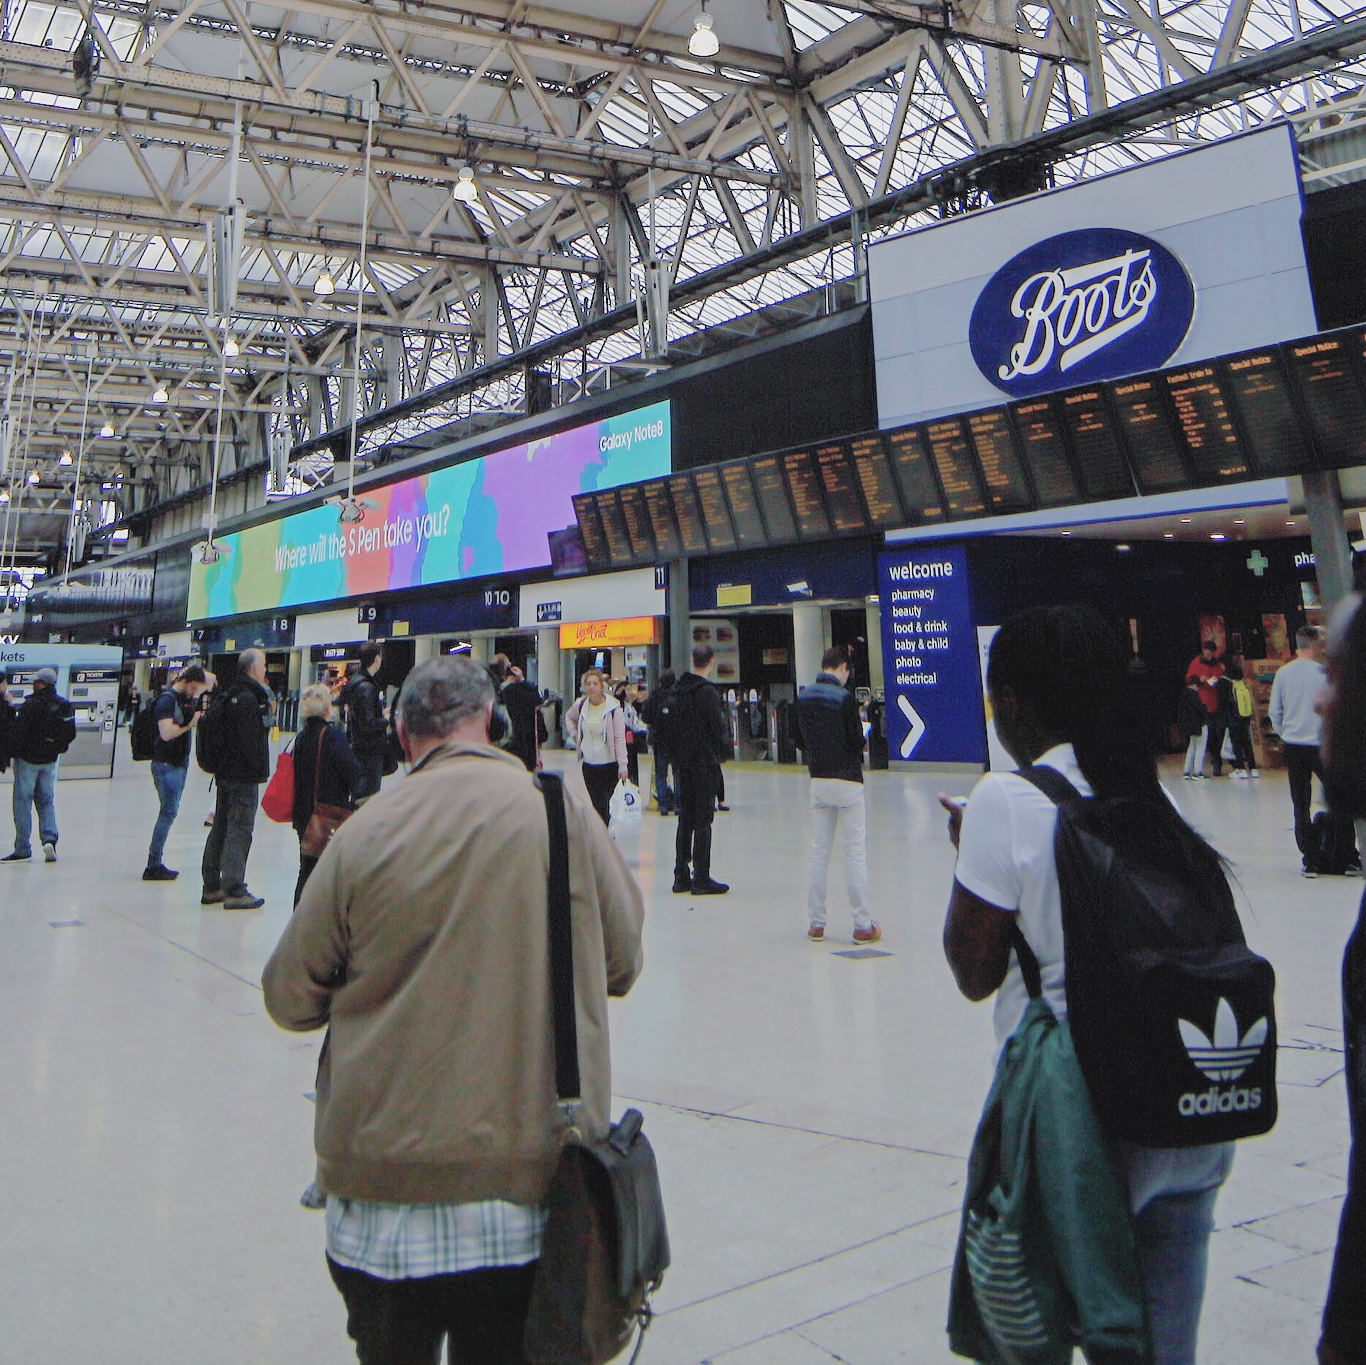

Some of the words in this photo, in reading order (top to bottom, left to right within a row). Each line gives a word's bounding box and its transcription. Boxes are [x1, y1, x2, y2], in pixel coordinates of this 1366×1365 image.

[996, 247, 1158, 382] Boots
[1294, 344, 1320, 357] Special
[599, 429, 632, 452] Galaxy
[634, 420, 664, 440] Note8
[274, 543, 307, 572] Where
[309, 533, 326, 564] will
[328, 532, 347, 559] the
[348, 528, 356, 556] S
[357, 525, 381, 554] Pen
[383, 515, 413, 548] take
[415, 503, 451, 552] you?
[656, 567, 665, 585] 11
[889, 561, 954, 580] welcome
[493, 589, 510, 606] 10
[891, 588, 935, 602] pharmacy
[368, 608, 377, 621] 9
[892, 605, 922, 618] beauty
[280, 619, 288, 630] 8
[893, 621, 914, 634] food
[915, 622, 923, 632] &
[923, 620, 948, 632] drink
[147, 636, 154, 646] 6
[197, 630, 204, 640] 7
[894, 639, 917, 653] baby
[917, 639, 925, 650] &
[926, 637, 949, 649] child
[895, 656, 922, 669] photo
[896, 672, 937, 685] electrical
[1177, 1085, 1263, 1117] adidas
